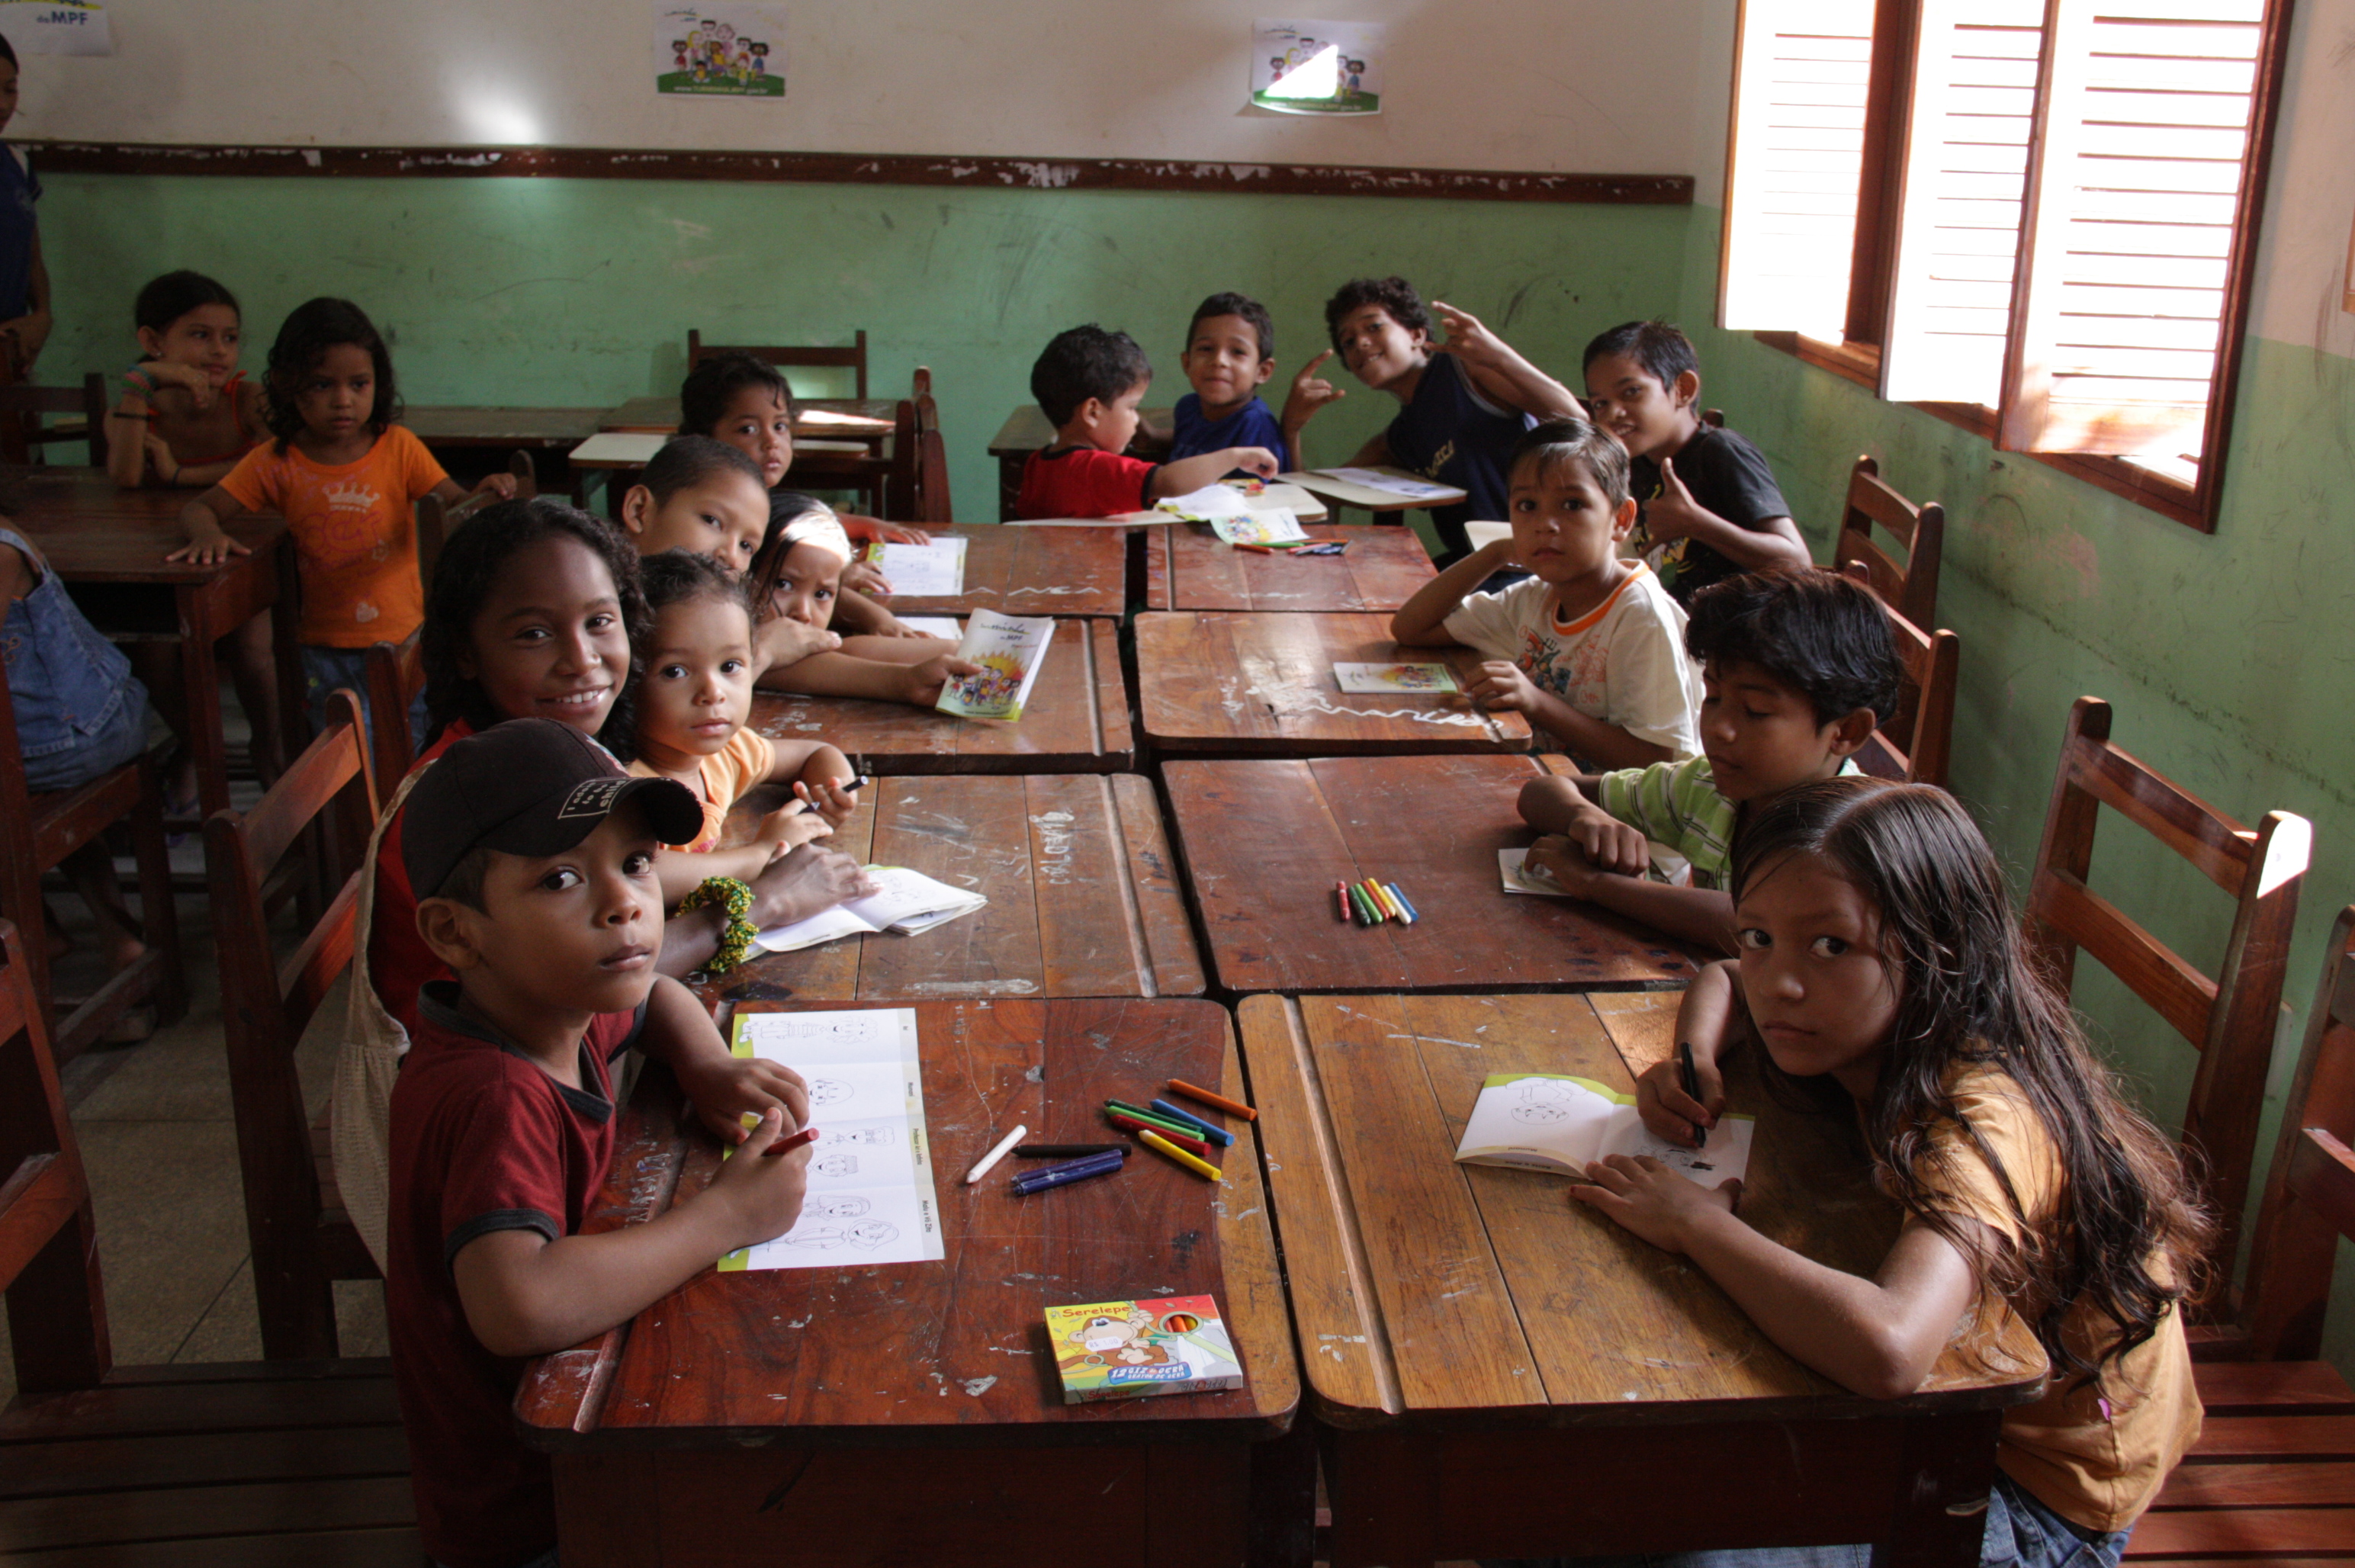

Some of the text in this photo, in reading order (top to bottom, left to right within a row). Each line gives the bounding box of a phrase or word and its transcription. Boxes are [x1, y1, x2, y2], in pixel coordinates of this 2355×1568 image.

[51, 11, 88, 25] MPF
[1062, 1306, 1130, 1318] Serelepe
[1111, 1369, 1126, 1379] 12
[1088, 1389, 1130, 1399] Serelepe
